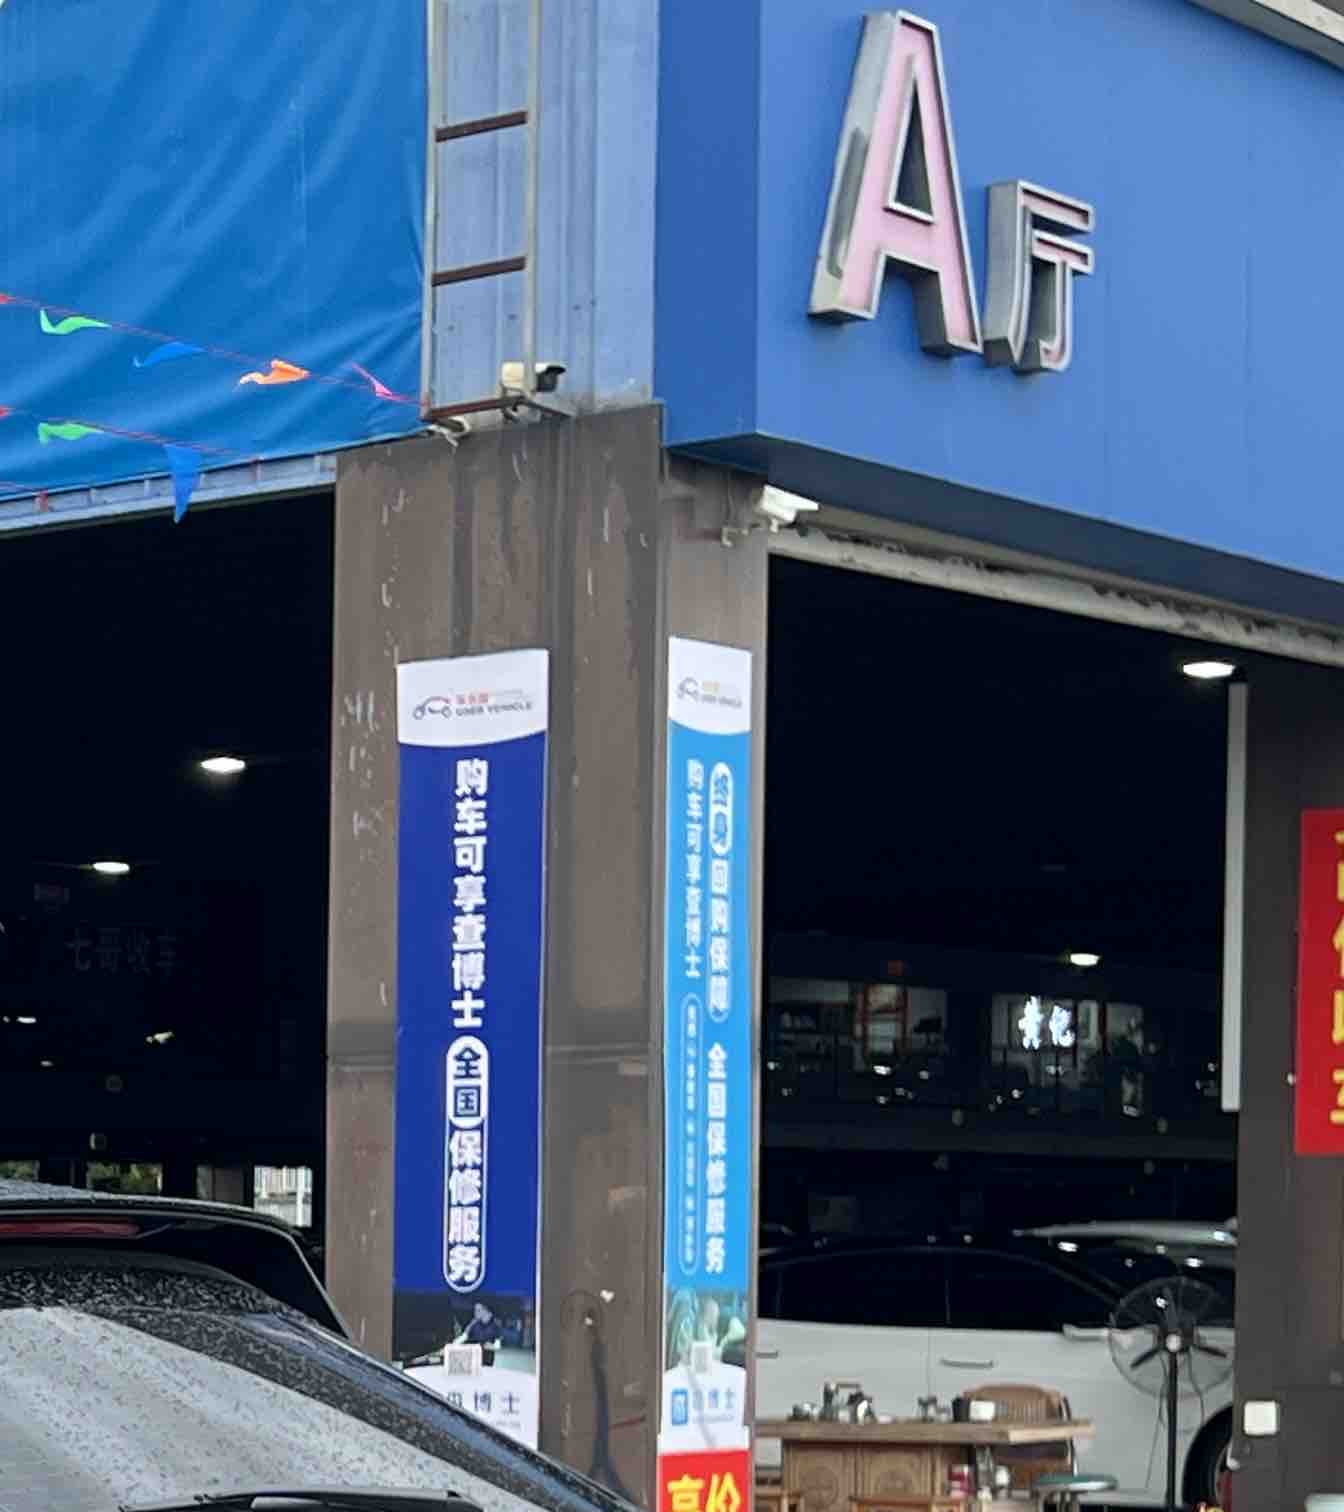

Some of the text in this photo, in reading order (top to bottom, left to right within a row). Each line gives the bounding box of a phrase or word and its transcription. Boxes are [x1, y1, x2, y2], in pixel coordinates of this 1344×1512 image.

[447, 758, 489, 1283] 购车可享查博士 全国 保修服务
